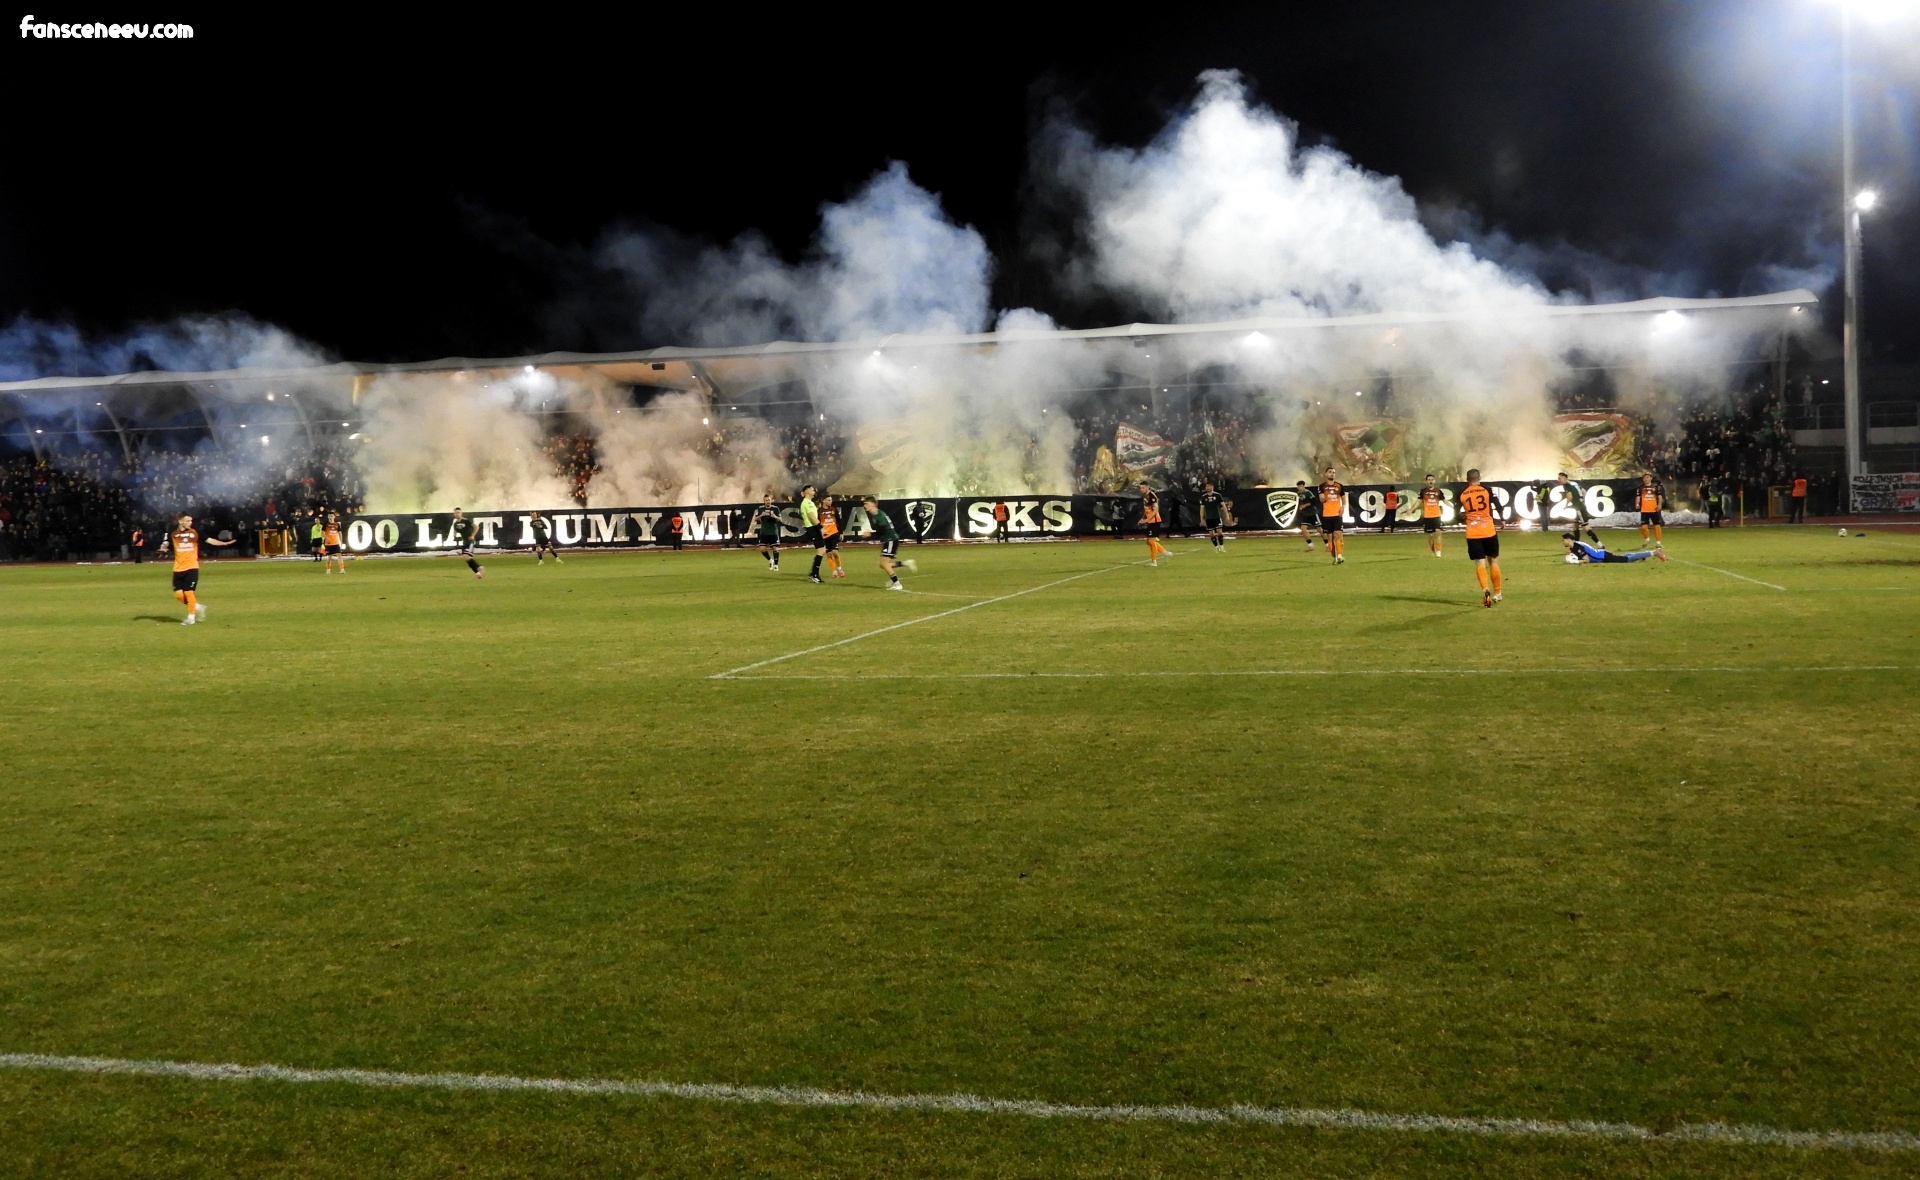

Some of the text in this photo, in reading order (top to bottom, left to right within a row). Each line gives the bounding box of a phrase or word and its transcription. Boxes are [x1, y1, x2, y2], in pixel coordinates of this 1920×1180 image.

[967, 500, 1073, 534] SKS
[1465, 494, 1488, 513] 13
[518, 513, 662, 545] DUMY
